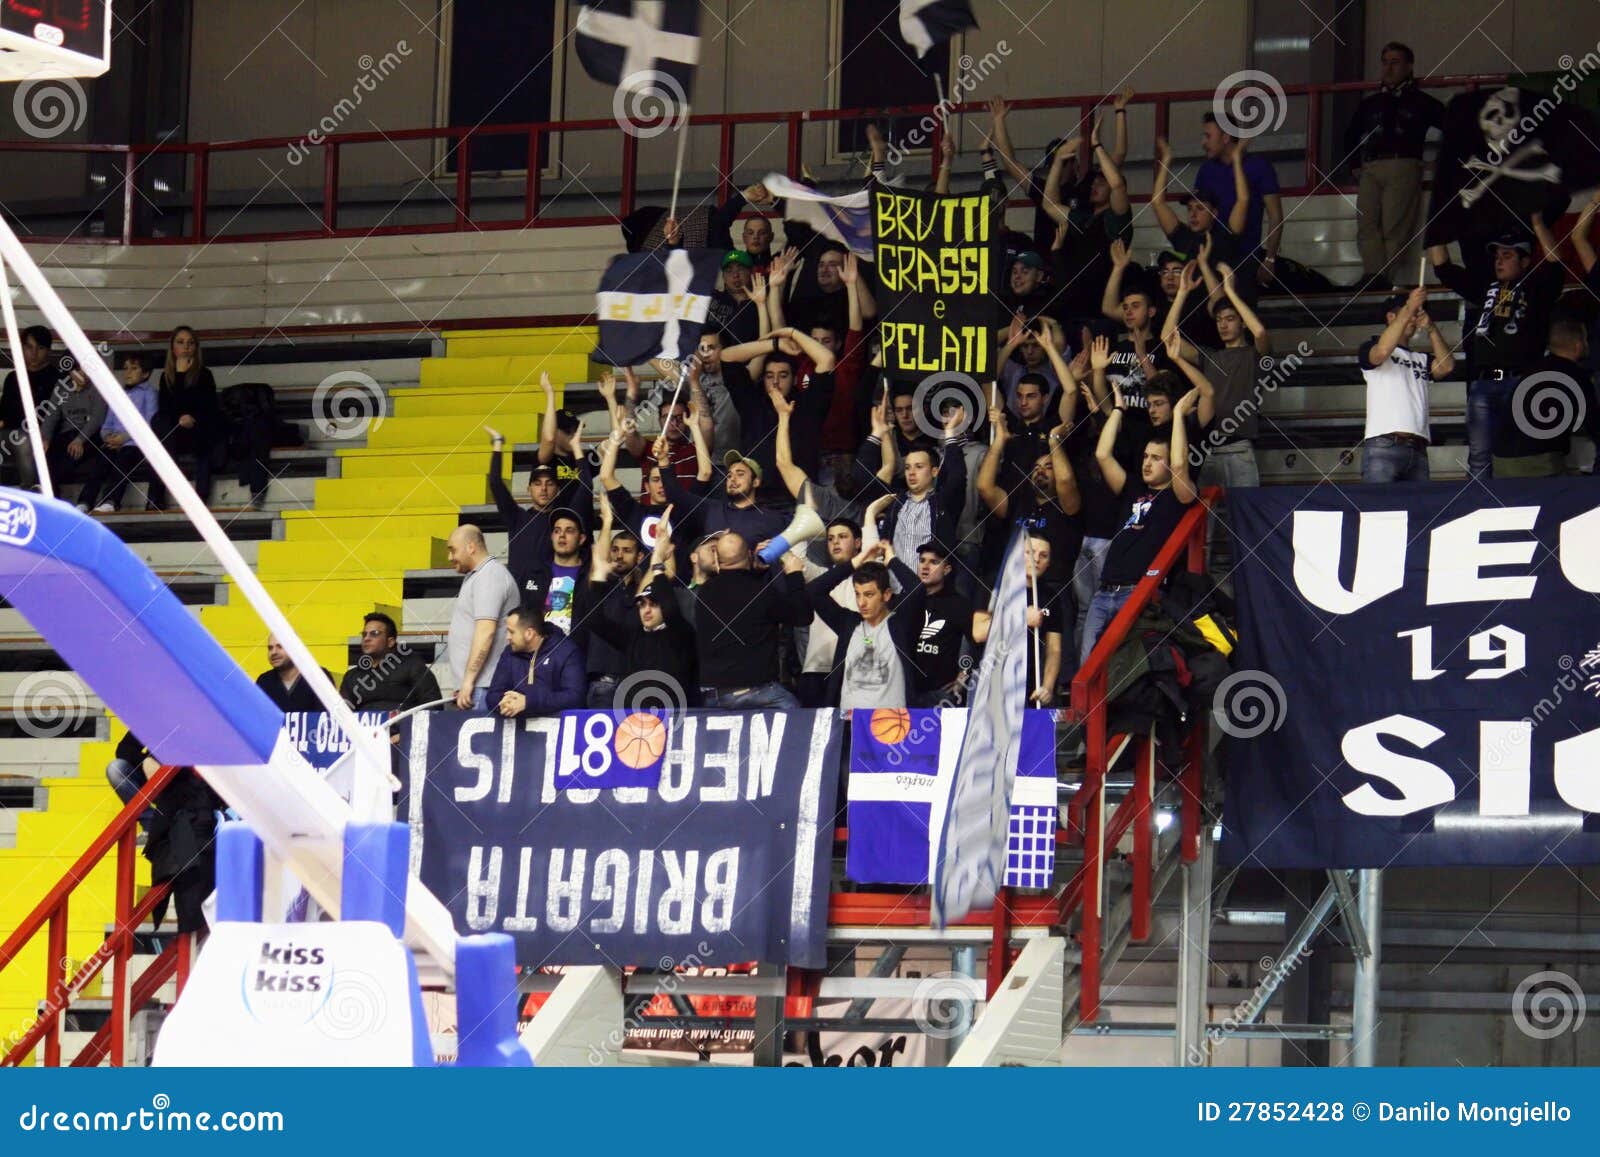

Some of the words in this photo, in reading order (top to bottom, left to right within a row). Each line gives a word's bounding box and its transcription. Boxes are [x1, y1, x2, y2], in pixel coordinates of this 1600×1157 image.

[876, 192, 990, 242] BRUTTI
[878, 243, 990, 294] GRASSI
[933, 299, 946, 319] e
[881, 321, 988, 373] PELATI
[1397, 624, 1526, 681] 19
[454, 712, 788, 804] NEALIS
[558, 713, 614, 777] 81
[466, 846, 741, 936] BRIGATA
[259, 942, 325, 965] kiss
[254, 970, 321, 993] kiss
